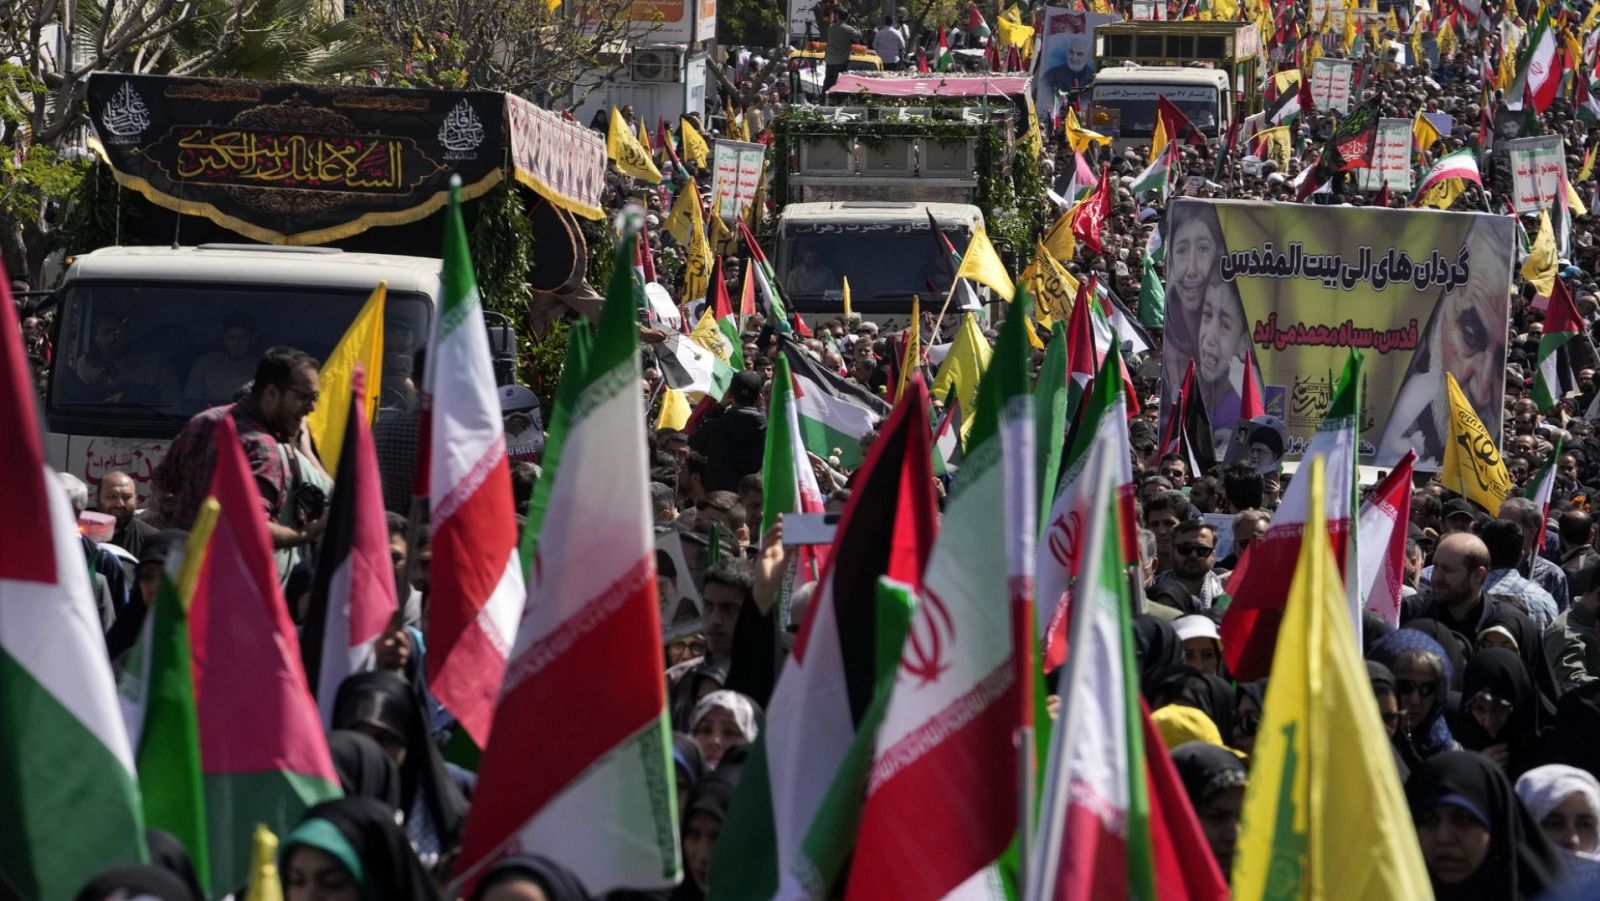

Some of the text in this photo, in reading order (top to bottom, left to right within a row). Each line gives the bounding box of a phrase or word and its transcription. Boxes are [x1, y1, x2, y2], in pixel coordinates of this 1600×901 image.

[1219, 241, 1470, 295] گردان های الی بیت المقدس
[1297, 322, 1338, 347] محمد
[515, 443, 537, 455] HAVE
[104, 454, 132, 469] سلام
